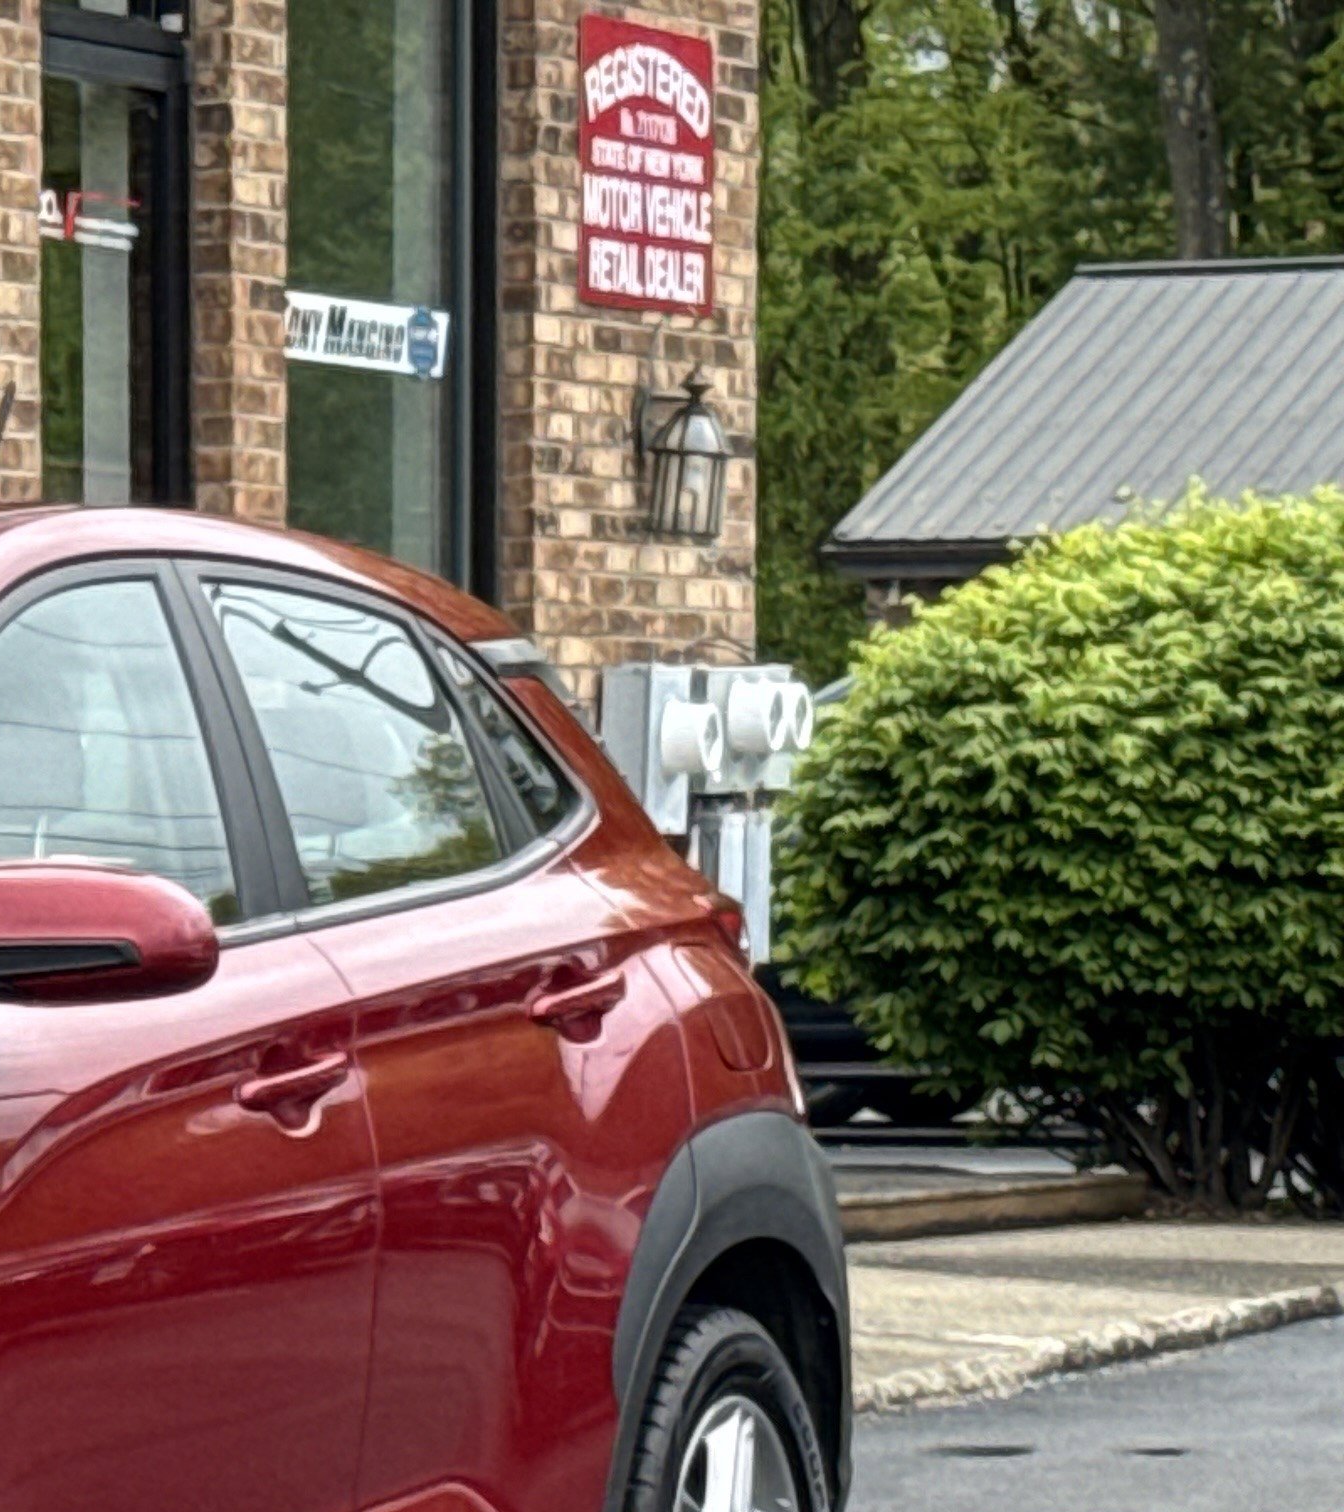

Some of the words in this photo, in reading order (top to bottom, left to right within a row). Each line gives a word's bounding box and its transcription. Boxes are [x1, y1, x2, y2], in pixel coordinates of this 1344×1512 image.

[584, 42, 710, 140] REGISTERED
[583, 172, 644, 233] MOTOR
[644, 182, 712, 245] VEHICLE
[588, 236, 644, 298] RETAIL
[644, 245, 706, 305] DEALER
[285, 306, 323, 353] ONY
